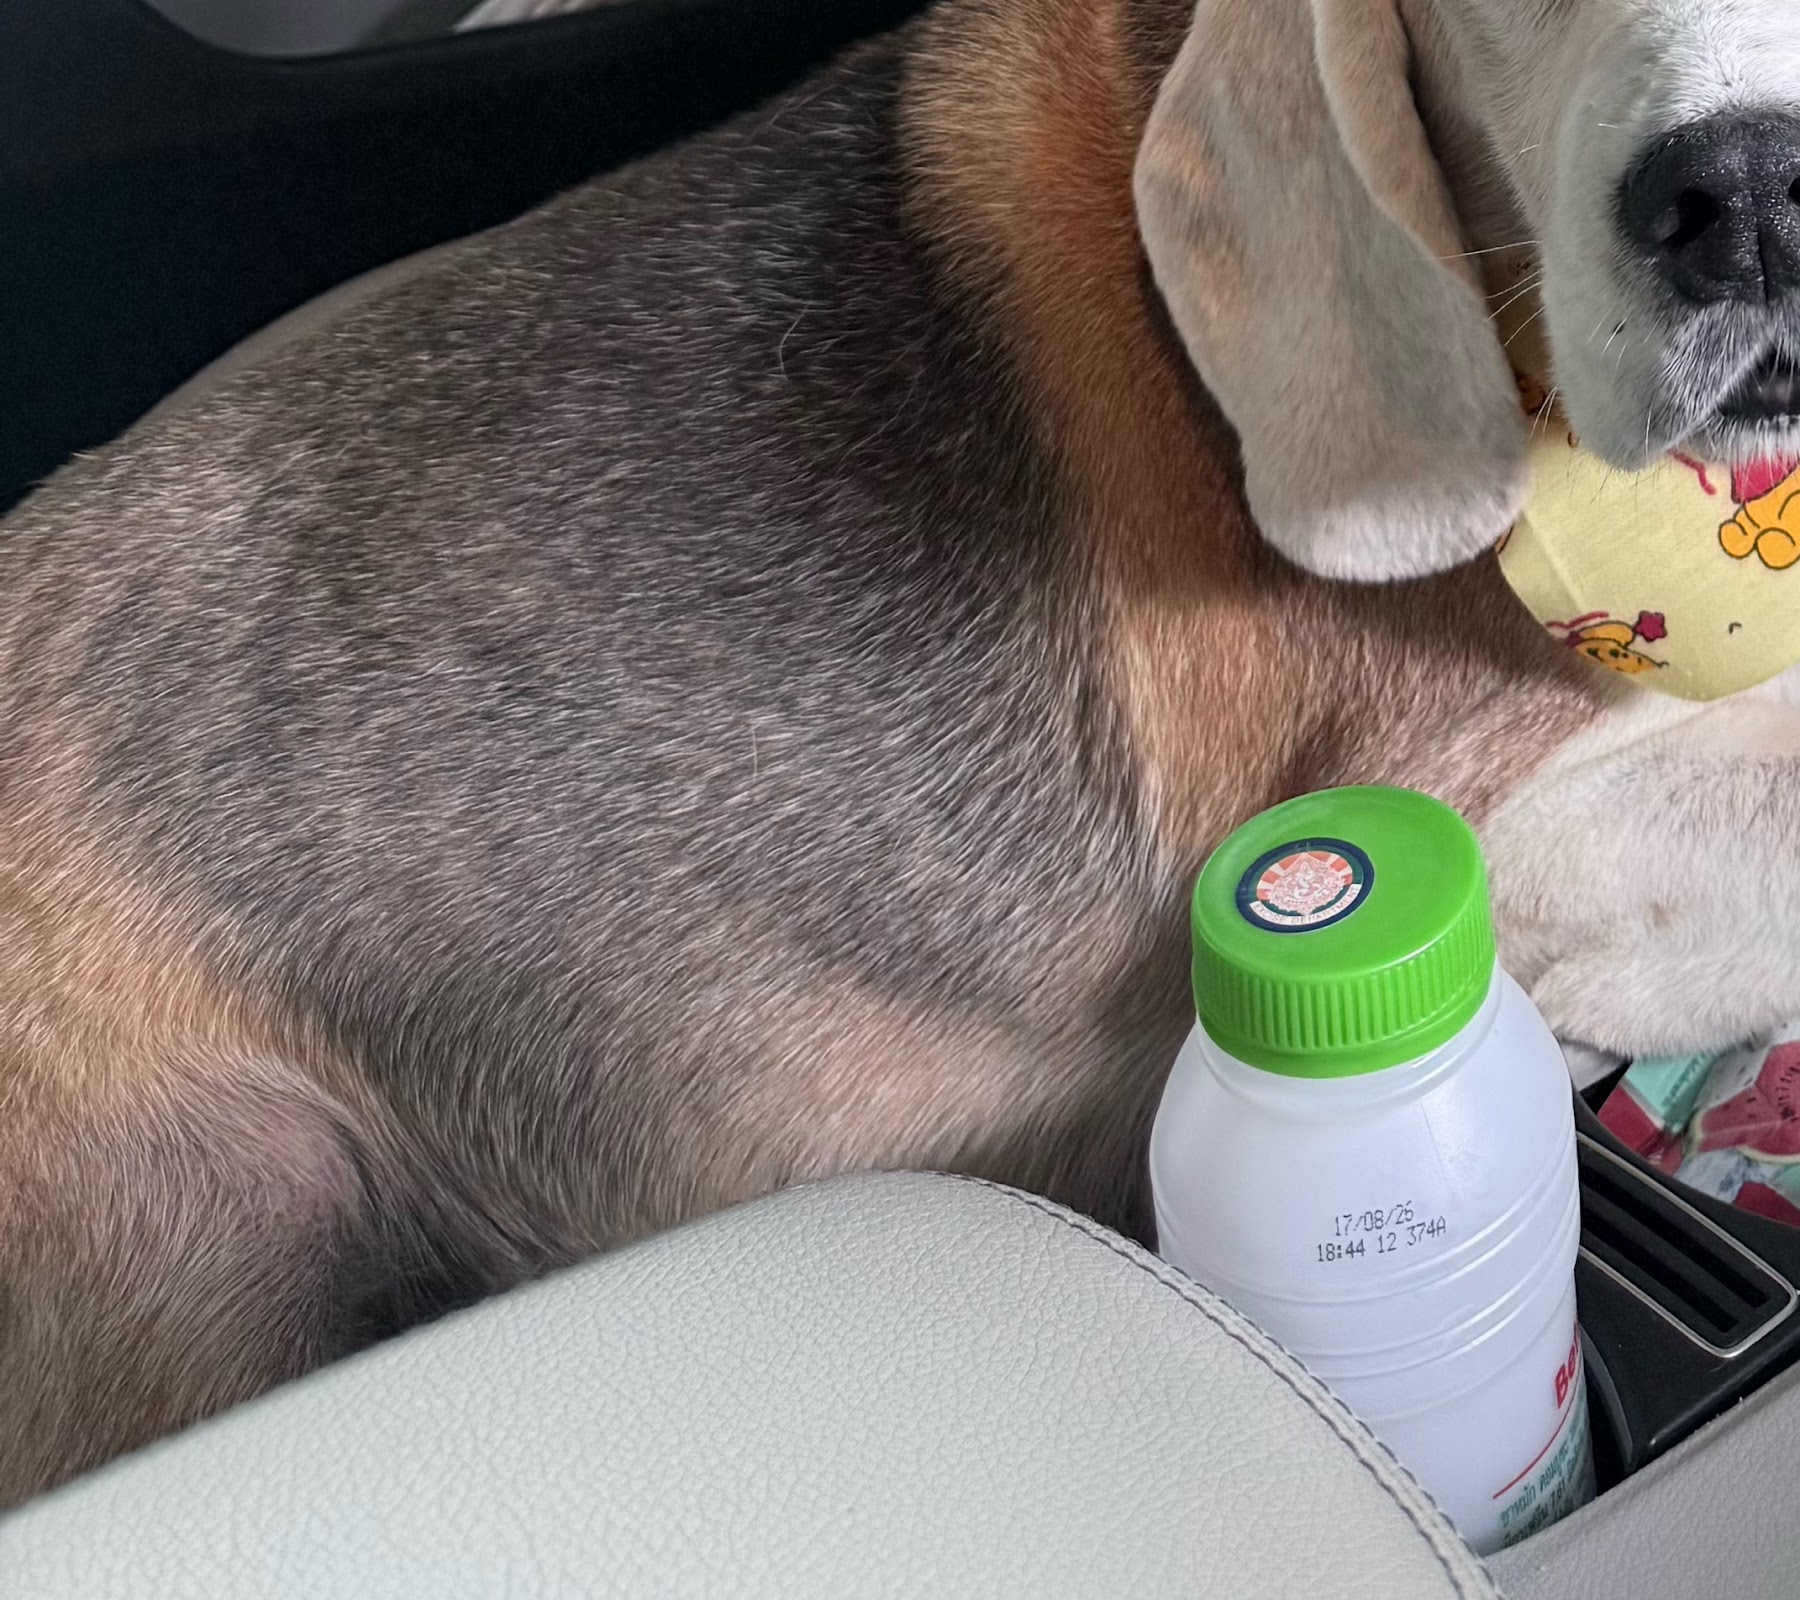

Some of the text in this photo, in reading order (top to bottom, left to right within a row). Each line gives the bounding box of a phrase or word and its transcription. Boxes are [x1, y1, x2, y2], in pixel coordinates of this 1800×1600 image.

[1291, 886, 1360, 925] DEPARTMENT
[1317, 1215, 1447, 1262] 18:44 12 374A
